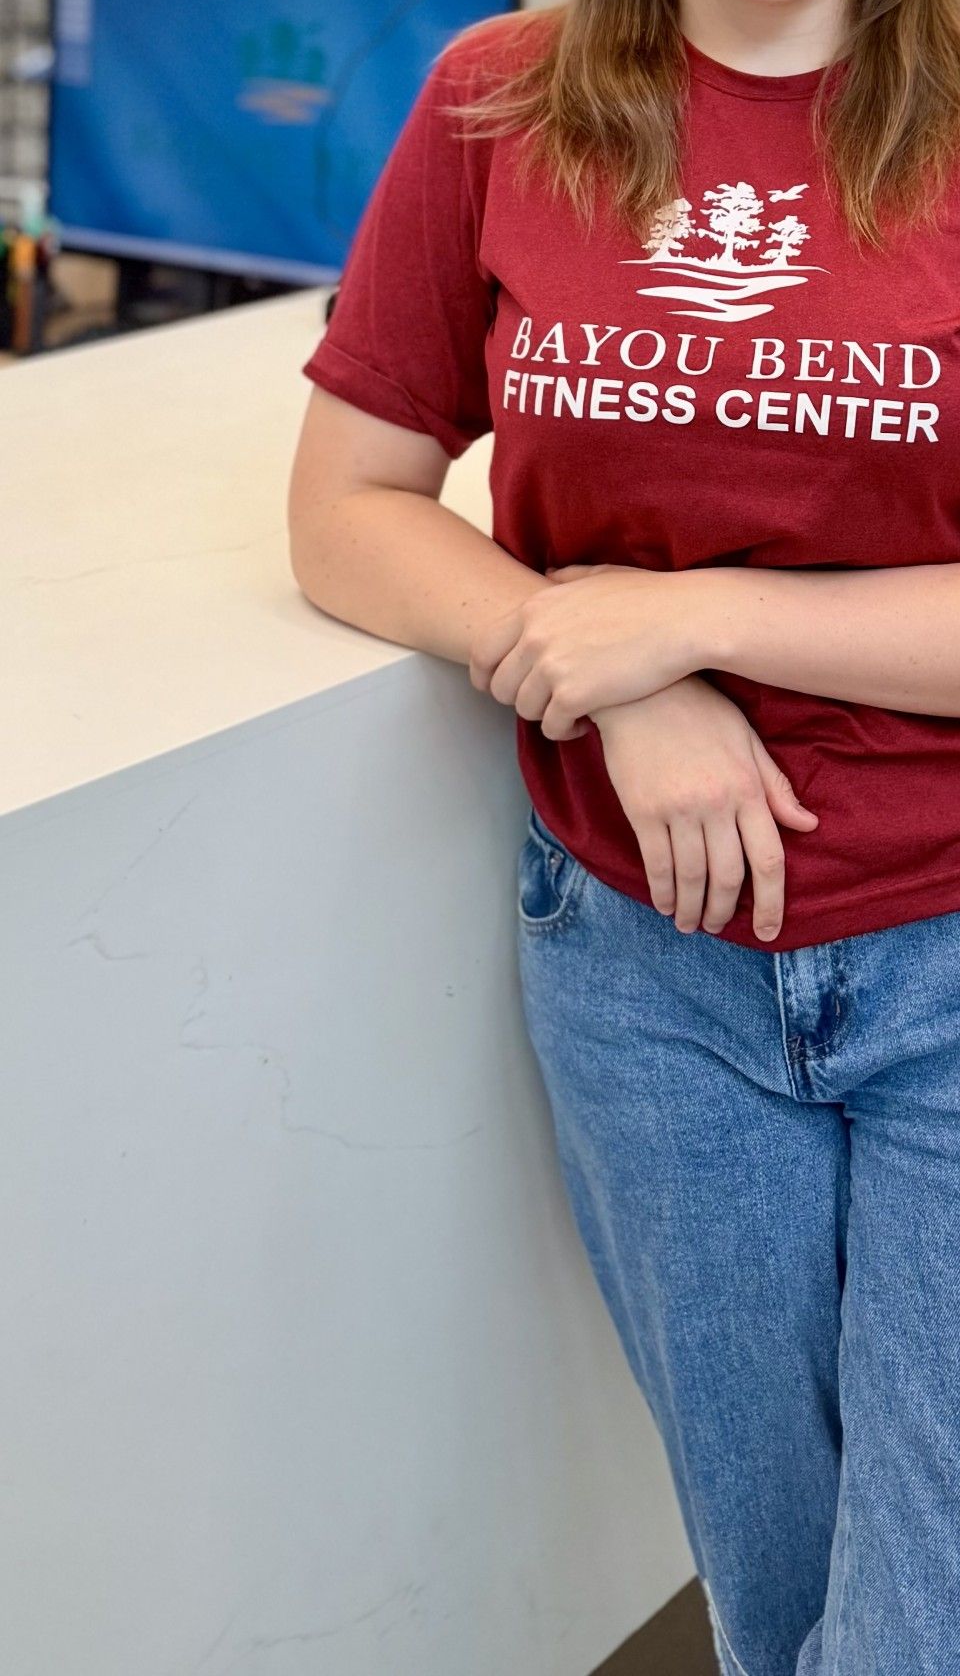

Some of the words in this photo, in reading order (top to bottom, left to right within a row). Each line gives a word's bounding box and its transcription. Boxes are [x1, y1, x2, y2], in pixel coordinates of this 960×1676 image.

[509, 316, 725, 377] BAYOU
[746, 337, 942, 390] BEND
[502, 370, 698, 425] FITNESS
[715, 388, 942, 444] CENTER
